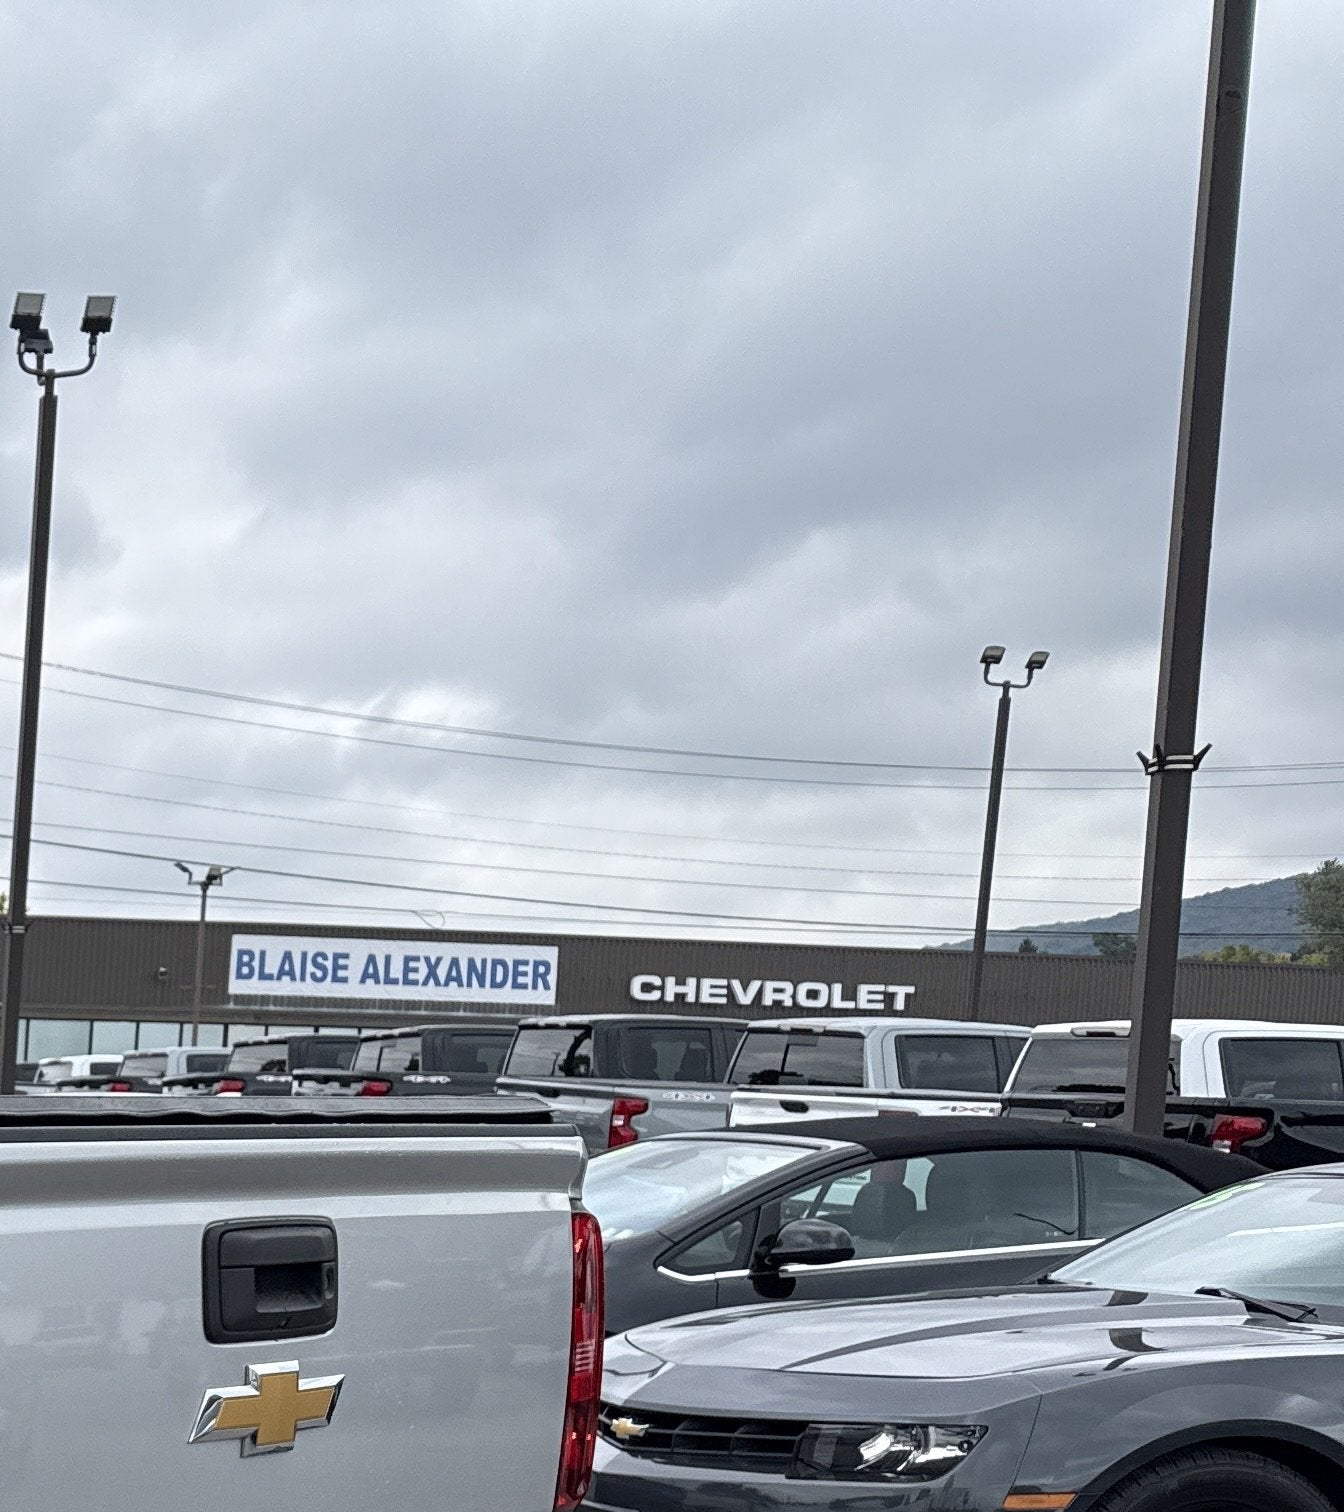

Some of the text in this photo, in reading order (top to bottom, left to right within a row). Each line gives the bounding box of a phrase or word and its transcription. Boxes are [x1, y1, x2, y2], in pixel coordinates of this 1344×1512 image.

[235, 949, 552, 991] BLAISE ALEXANDER
[629, 974, 916, 1011] CHEVROLET
